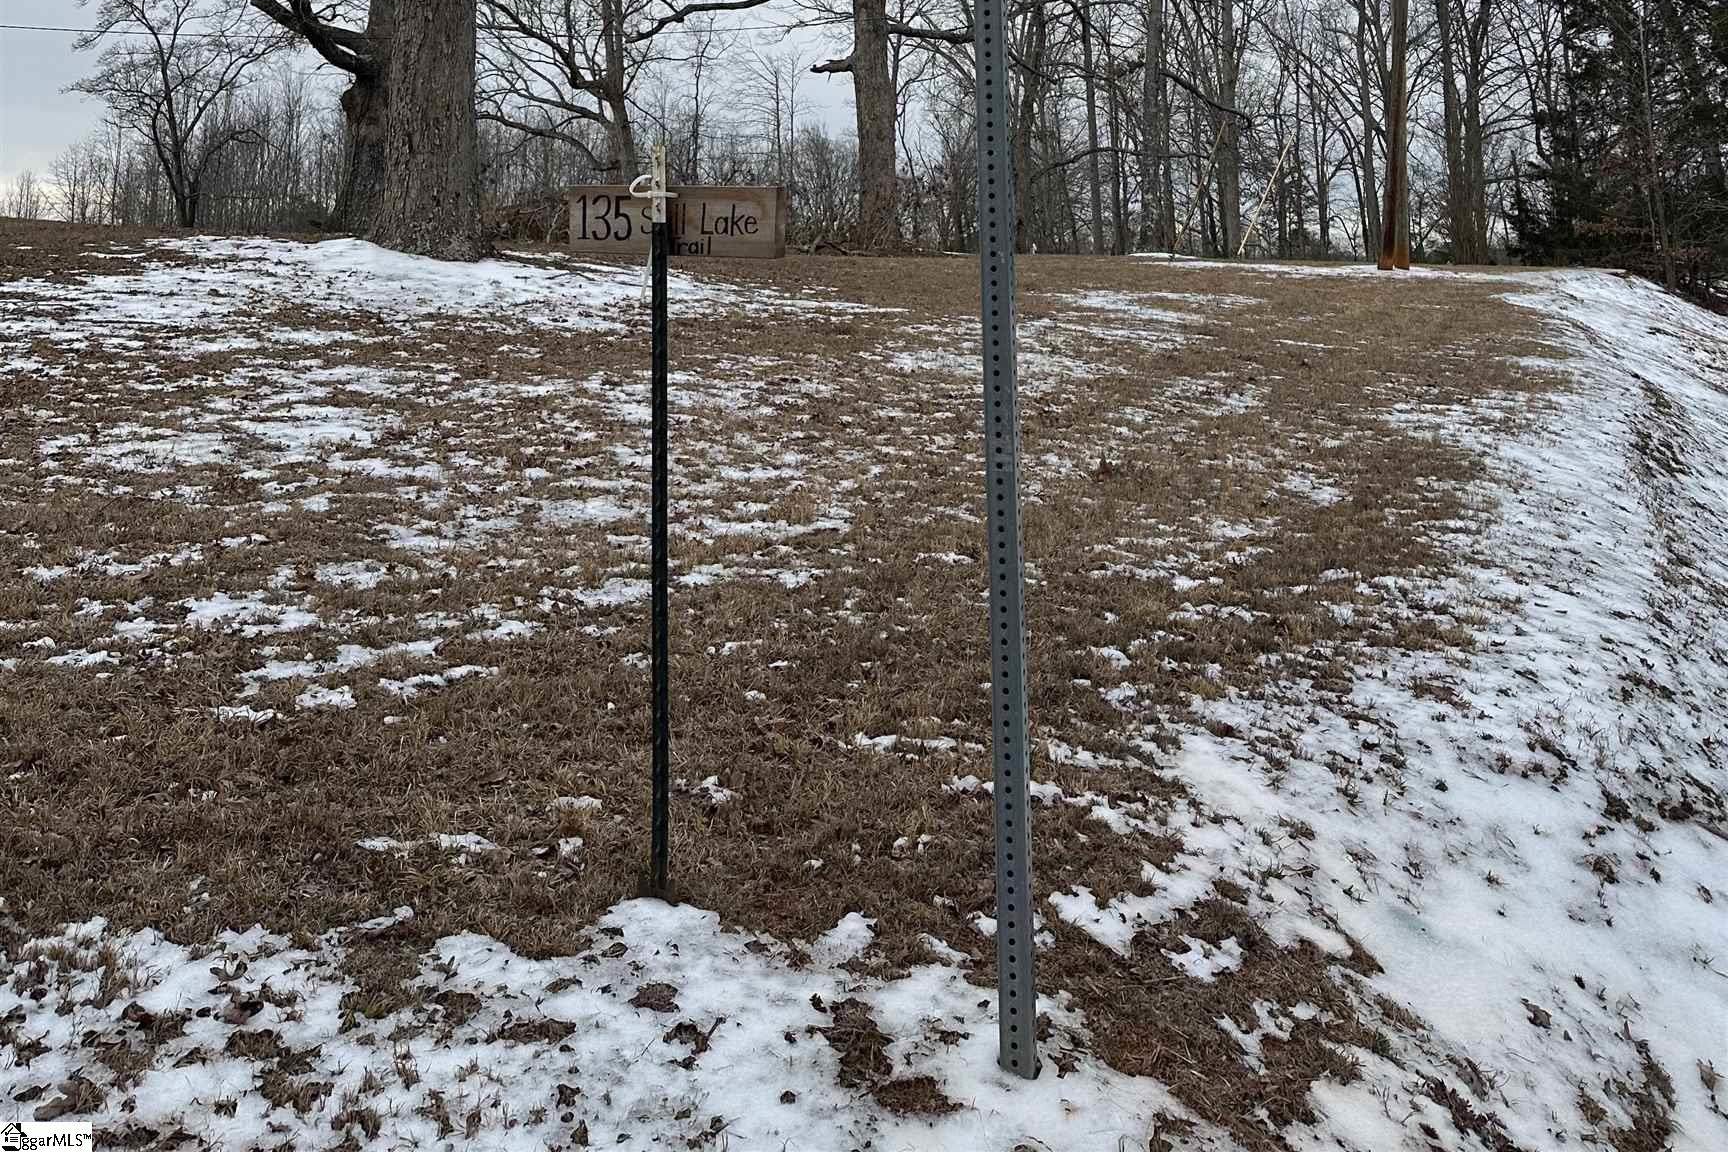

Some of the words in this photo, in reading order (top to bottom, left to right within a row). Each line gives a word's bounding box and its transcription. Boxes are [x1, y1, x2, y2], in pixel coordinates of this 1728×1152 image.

[576, 195, 632, 241] 135
[640, 203, 687, 235] Sll
[700, 202, 759, 237] Lake
